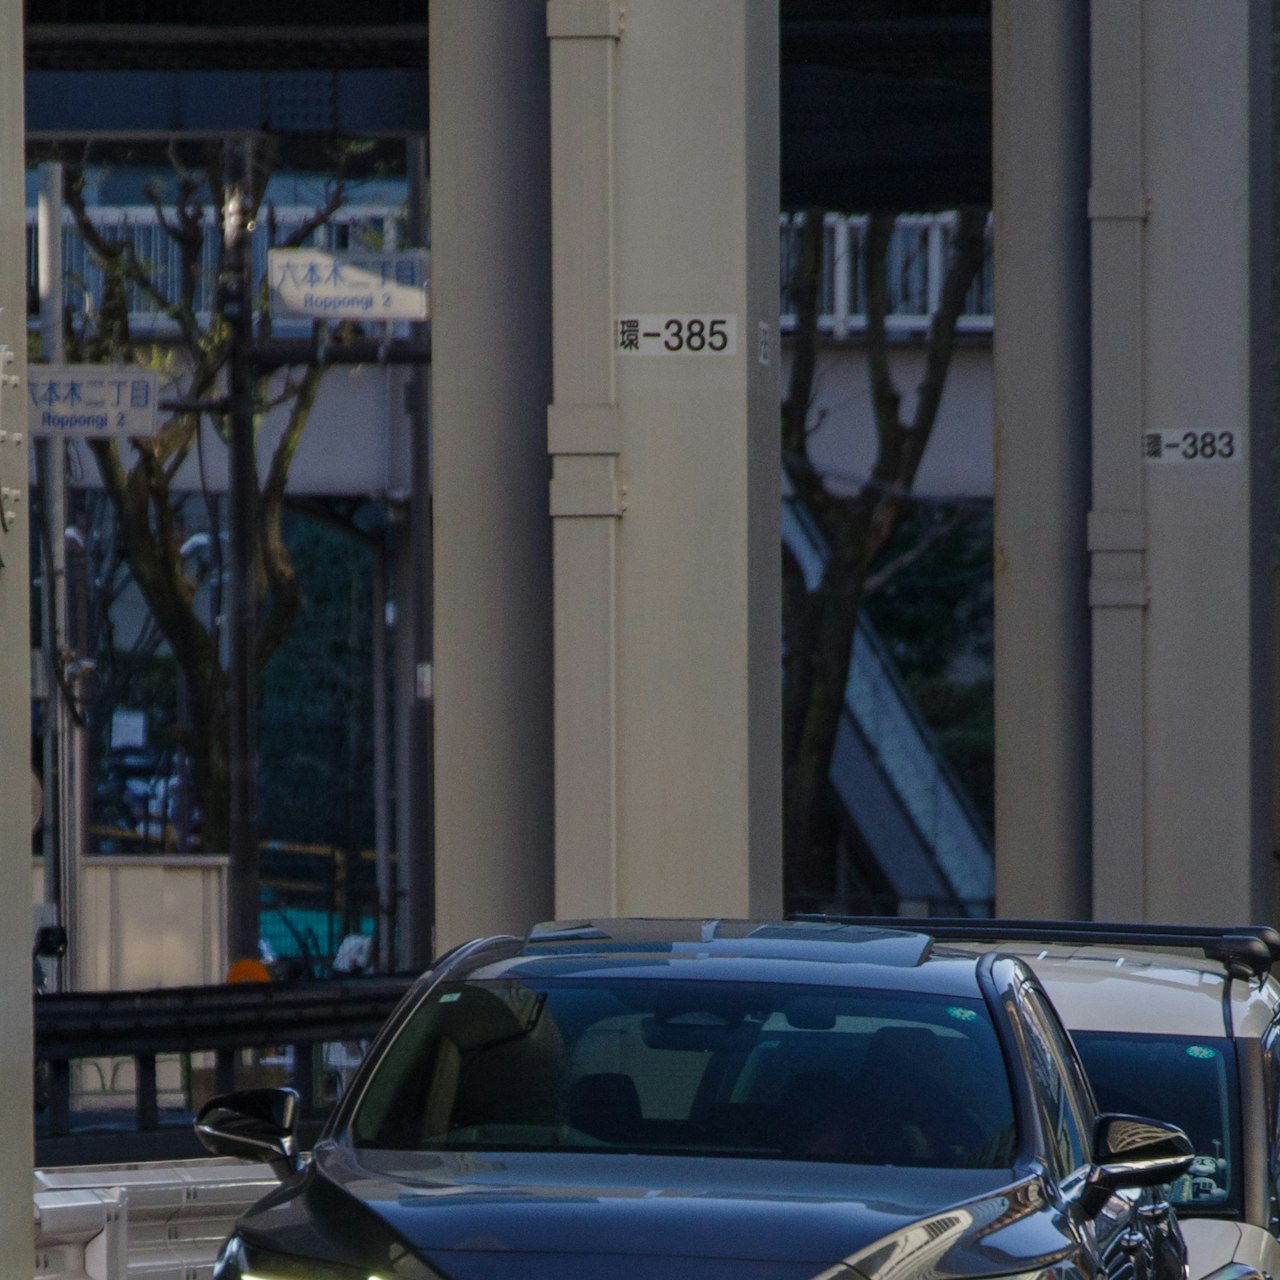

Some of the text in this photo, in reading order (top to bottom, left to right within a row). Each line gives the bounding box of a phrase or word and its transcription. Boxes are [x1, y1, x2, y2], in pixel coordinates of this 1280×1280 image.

[277, 260, 416, 289] 六本木二丁目
[304, 293, 392, 309] Roppongi 2
[620, 319, 728, 351] 環-385
[42, 411, 125, 430] Roppongi 2
